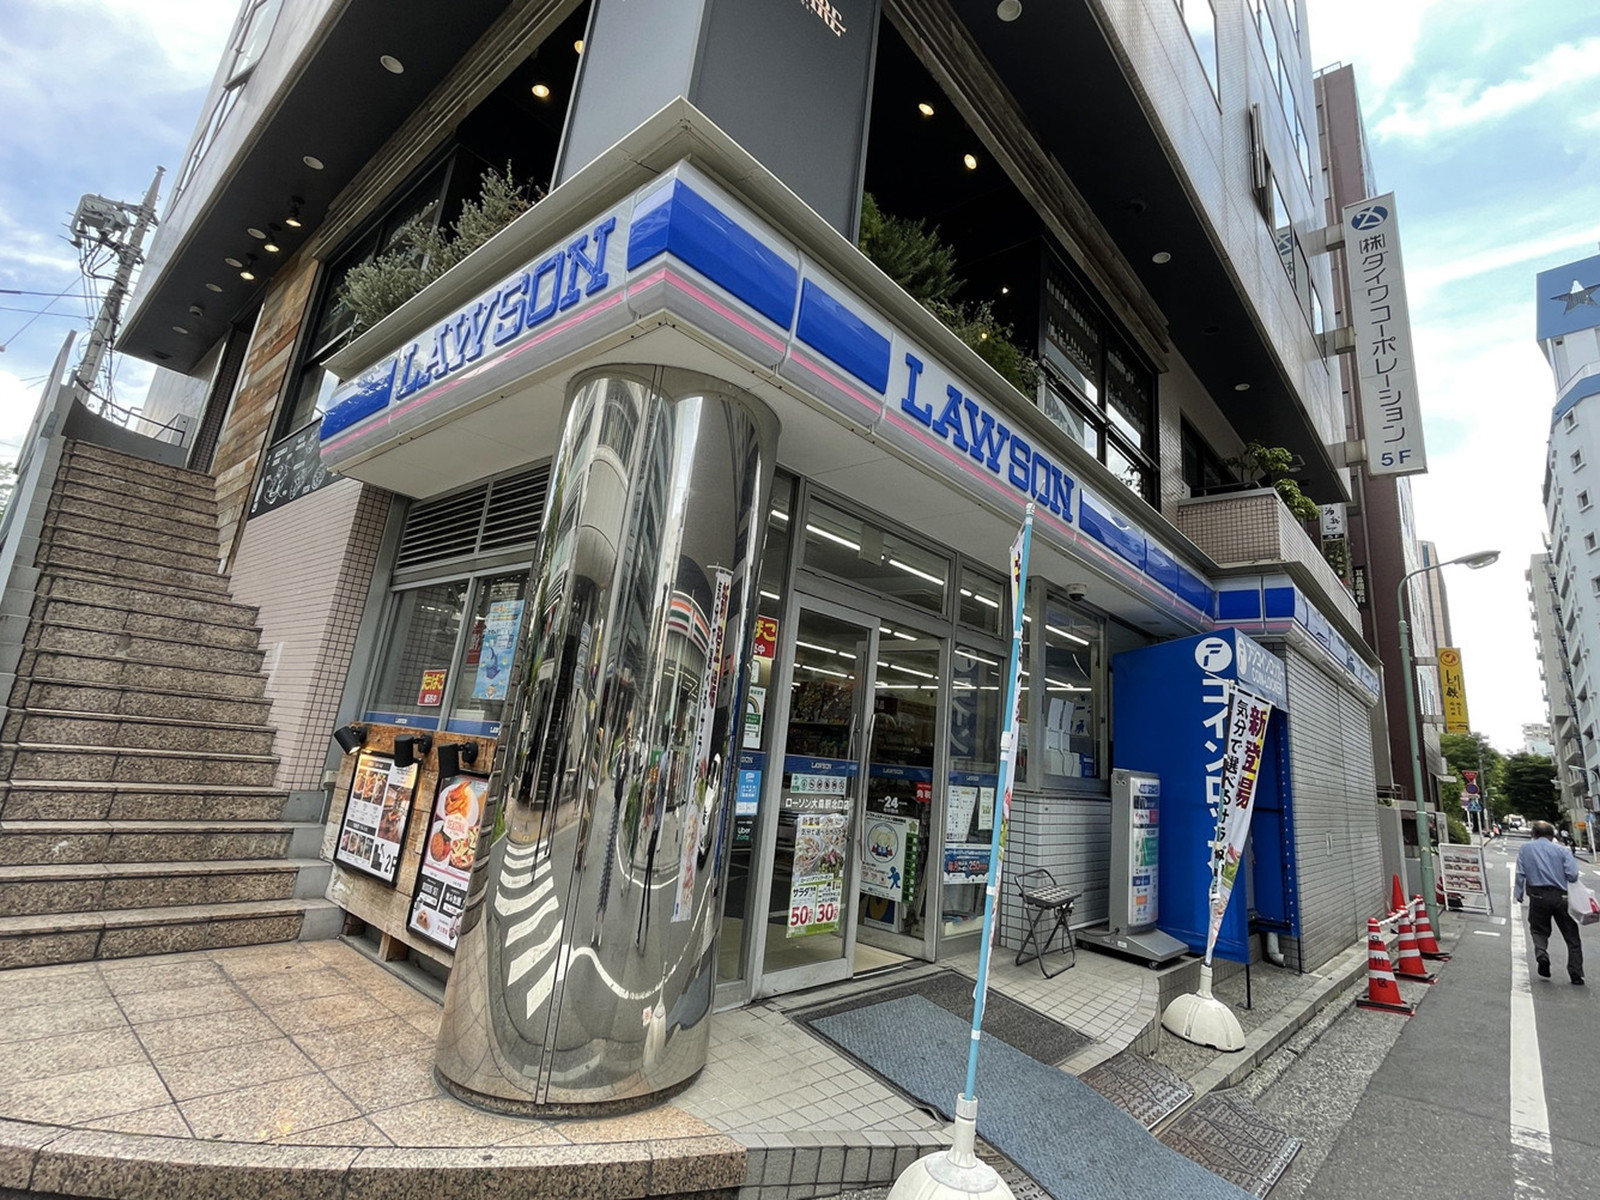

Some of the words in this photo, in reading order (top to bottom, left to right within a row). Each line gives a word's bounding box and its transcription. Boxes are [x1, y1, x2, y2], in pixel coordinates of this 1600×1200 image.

[396, 217, 617, 401] LAWSON
[901, 352, 1075, 524] LAWSON
[1381, 449, 1412, 467] 5F
[1236, 705, 1267, 810] 新登場
[884, 795, 899, 809] 24
[790, 905, 809, 926] 50
[817, 902, 834, 922] 30
